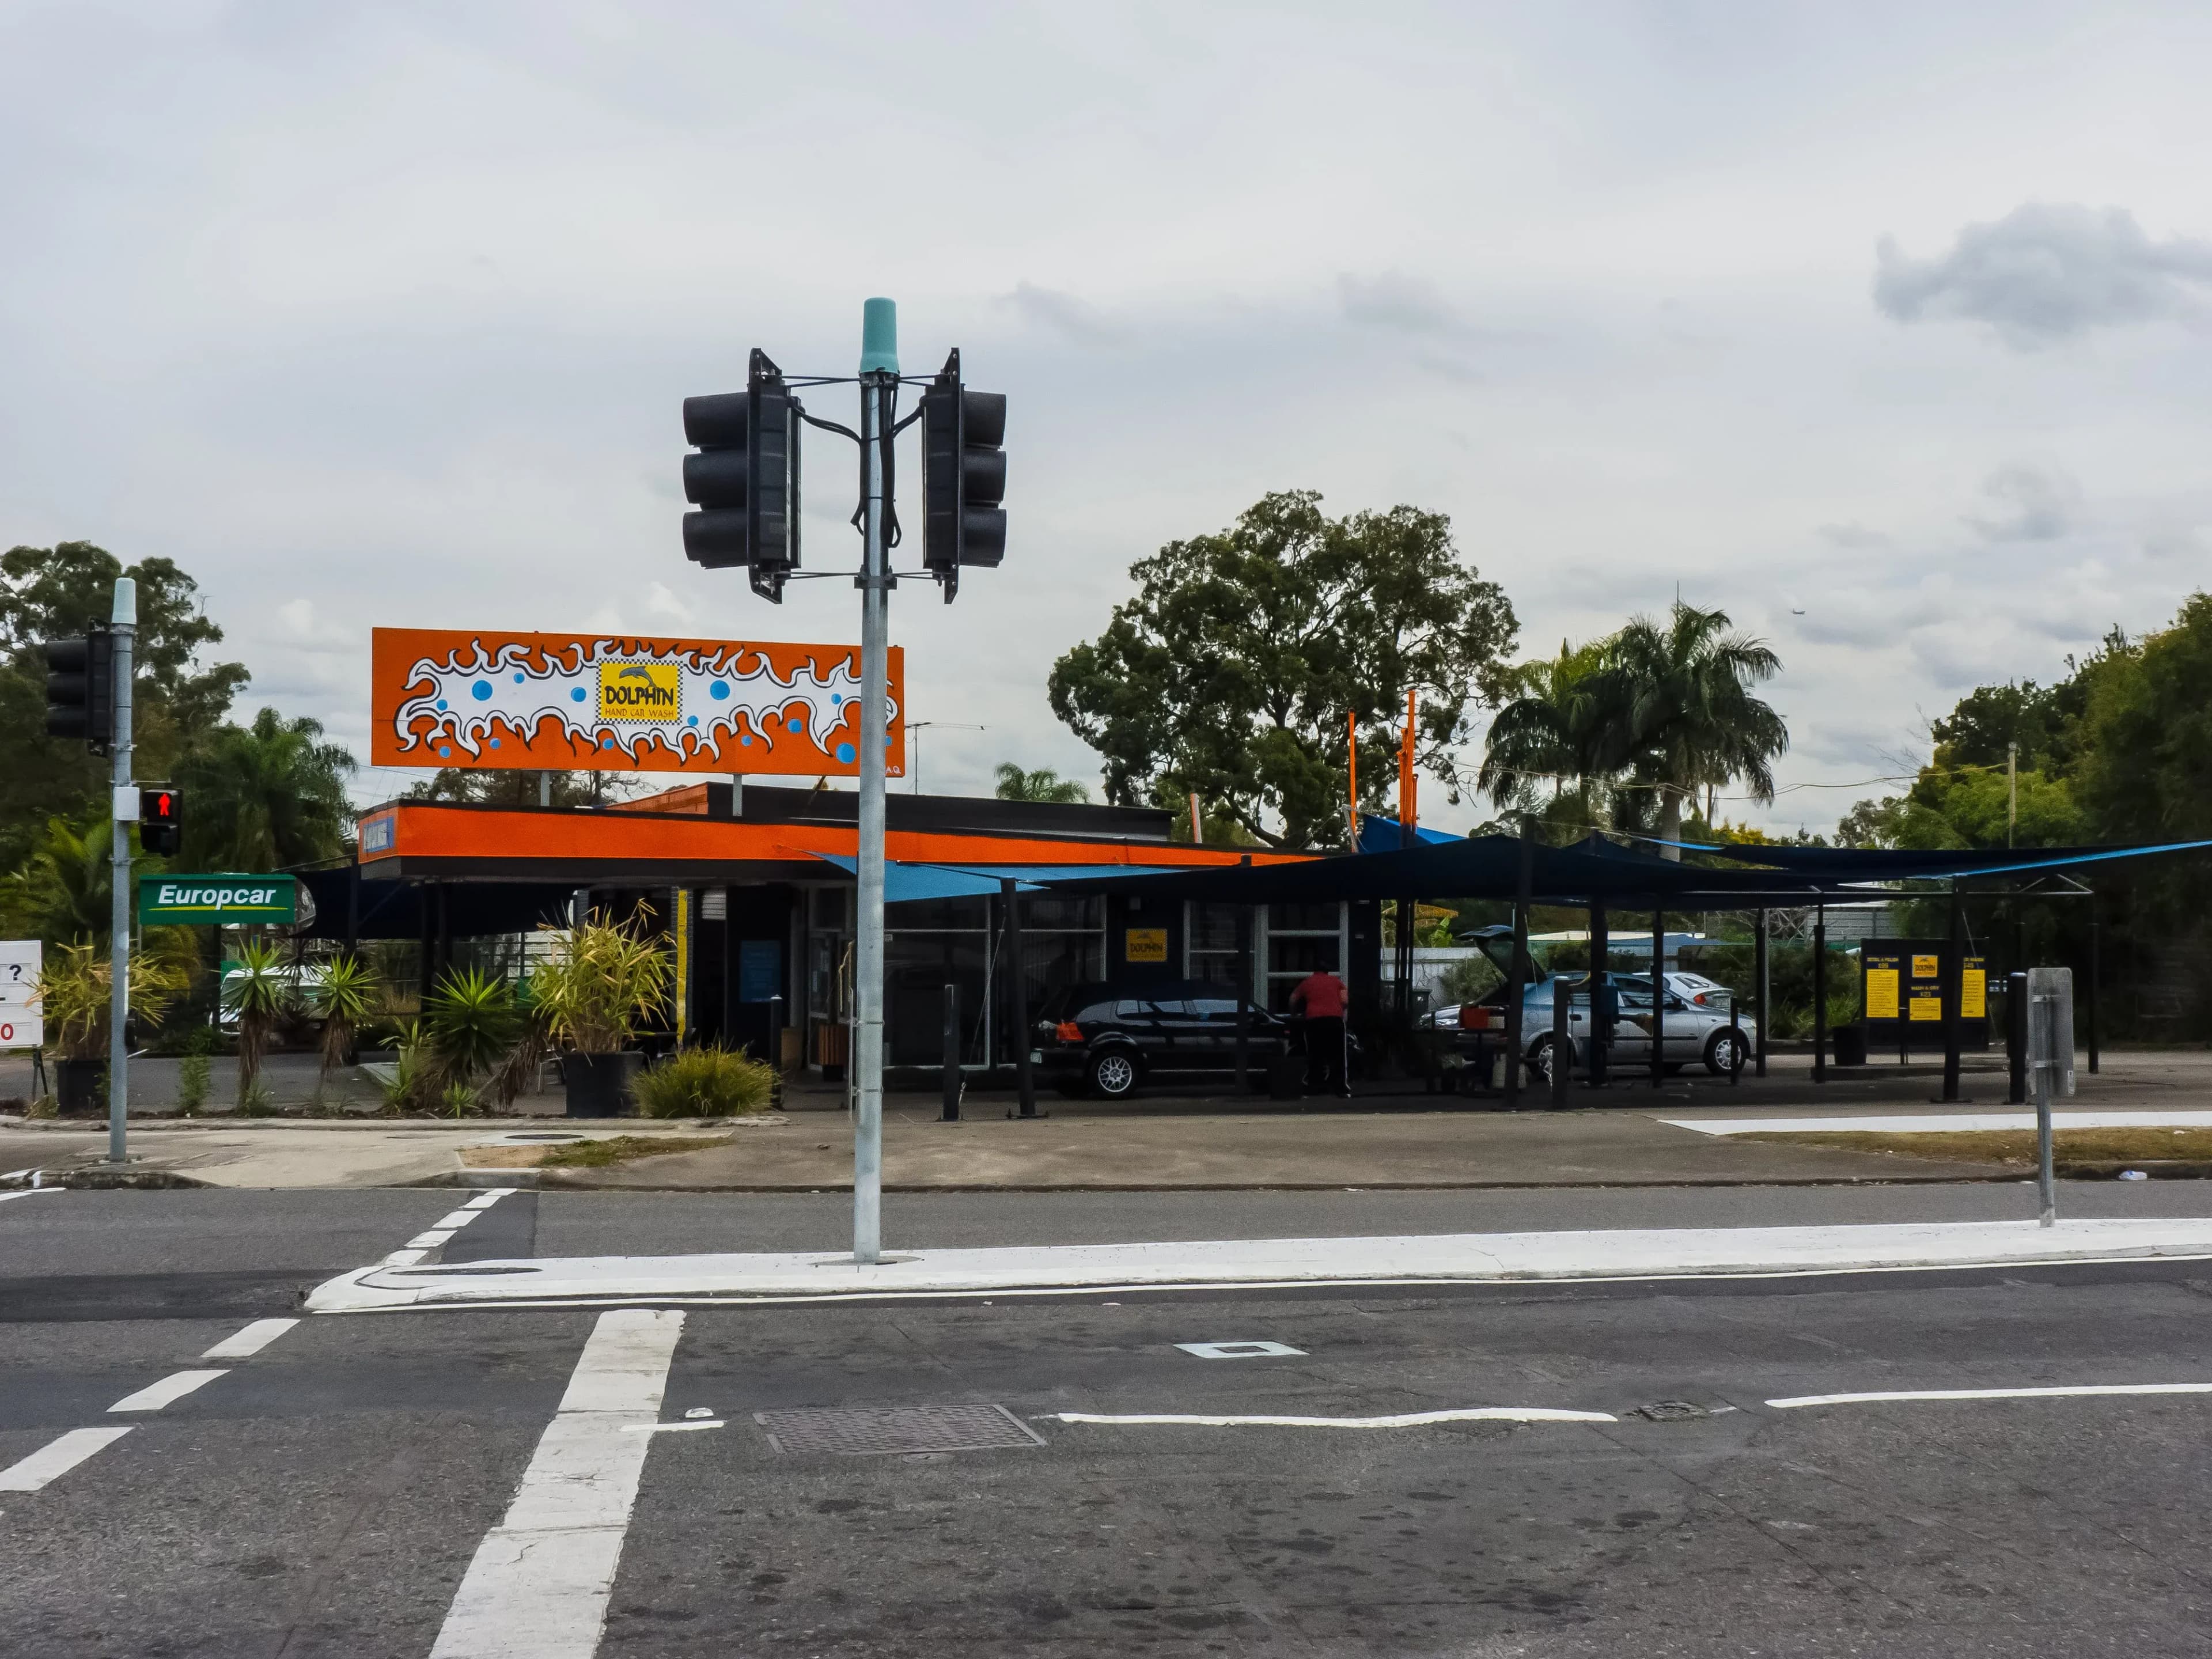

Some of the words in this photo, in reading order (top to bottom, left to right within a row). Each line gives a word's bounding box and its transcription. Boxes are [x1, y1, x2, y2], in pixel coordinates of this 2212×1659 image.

[604, 685, 674, 706] DOLPHIN
[605, 707, 627, 717] HAND
[630, 708, 645, 717] CAR
[649, 709, 674, 718] WASH
[158, 885, 276, 910] Europcar
[9, 965, 22, 980] ?
